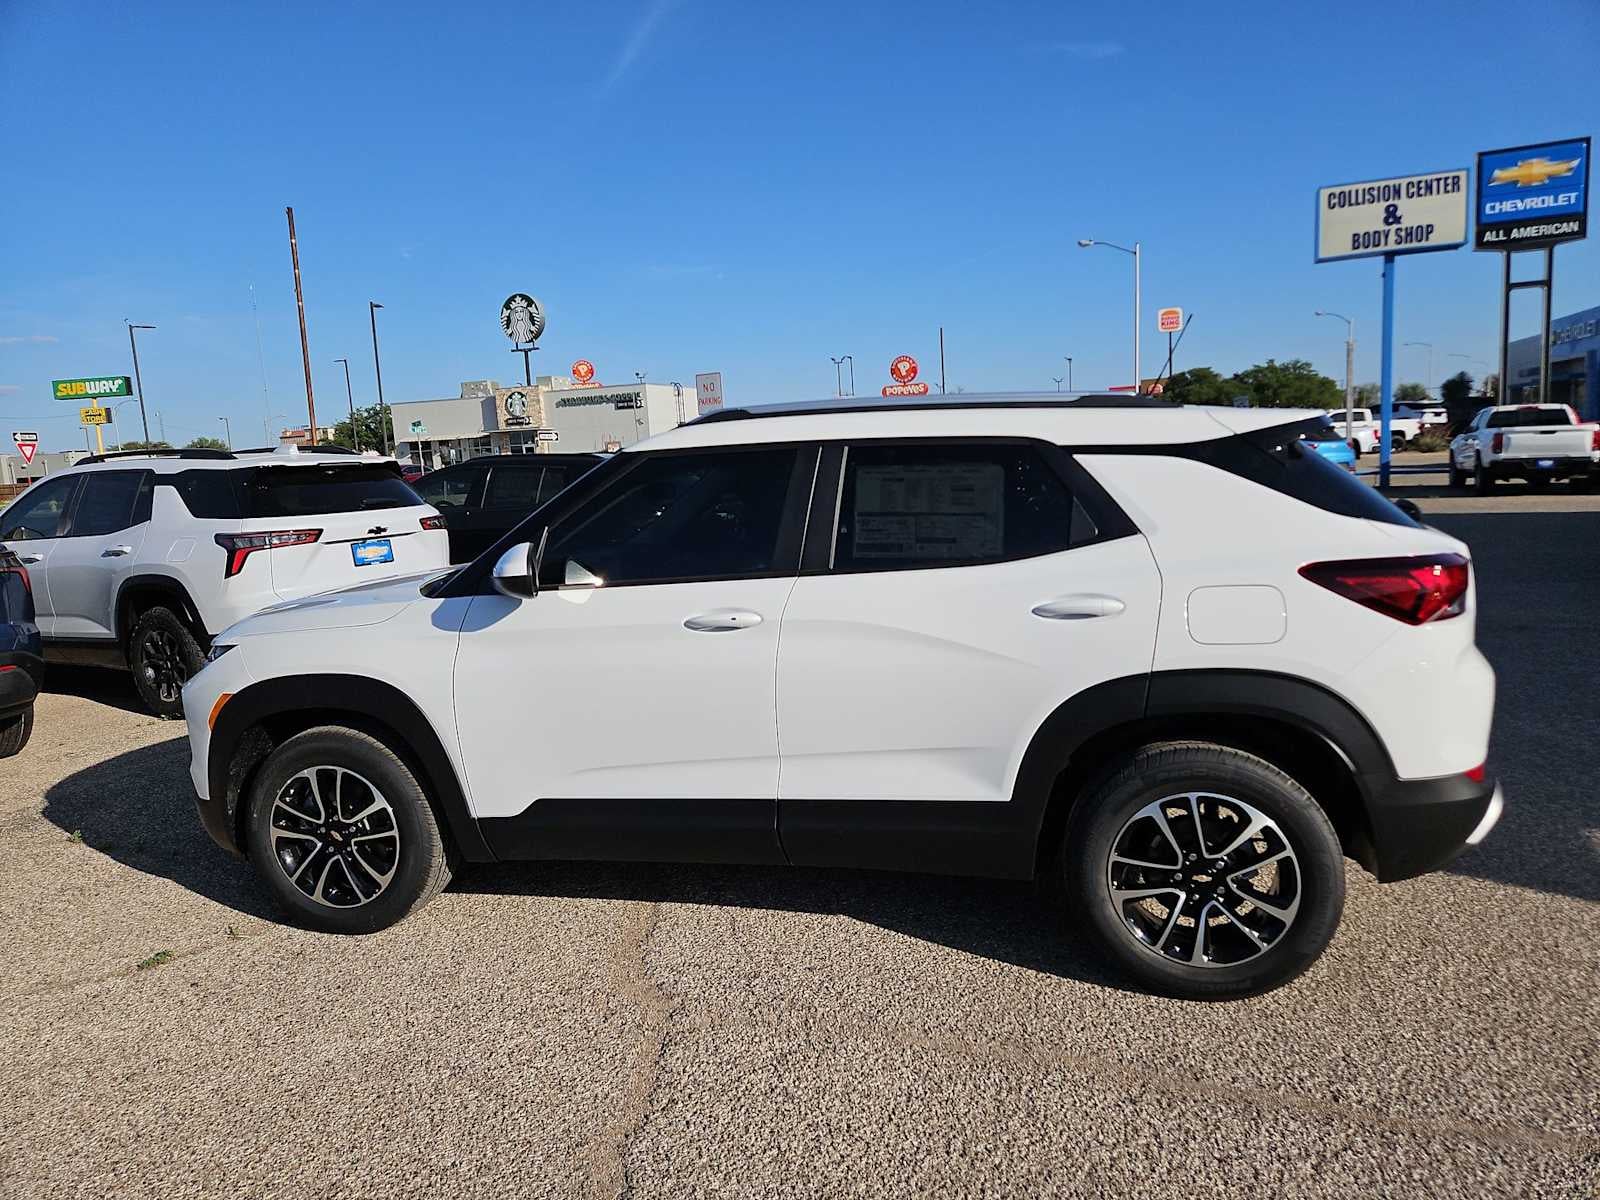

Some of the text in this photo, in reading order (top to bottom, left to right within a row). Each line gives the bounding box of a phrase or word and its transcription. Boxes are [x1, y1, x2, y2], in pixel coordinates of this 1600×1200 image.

[1327, 175, 1461, 210] COLLISION CENTER
[1485, 192, 1579, 214] CHEVROLET
[1383, 203, 1402, 226] &
[1352, 224, 1434, 251] BODY SHOP
[1483, 220, 1580, 242] ALL AMERICAN
[56, 378, 123, 397] SUBWAY
[703, 382, 715, 392] NO
[885, 384, 925, 395] POPEYES
[699, 396, 722, 406] PARKING
